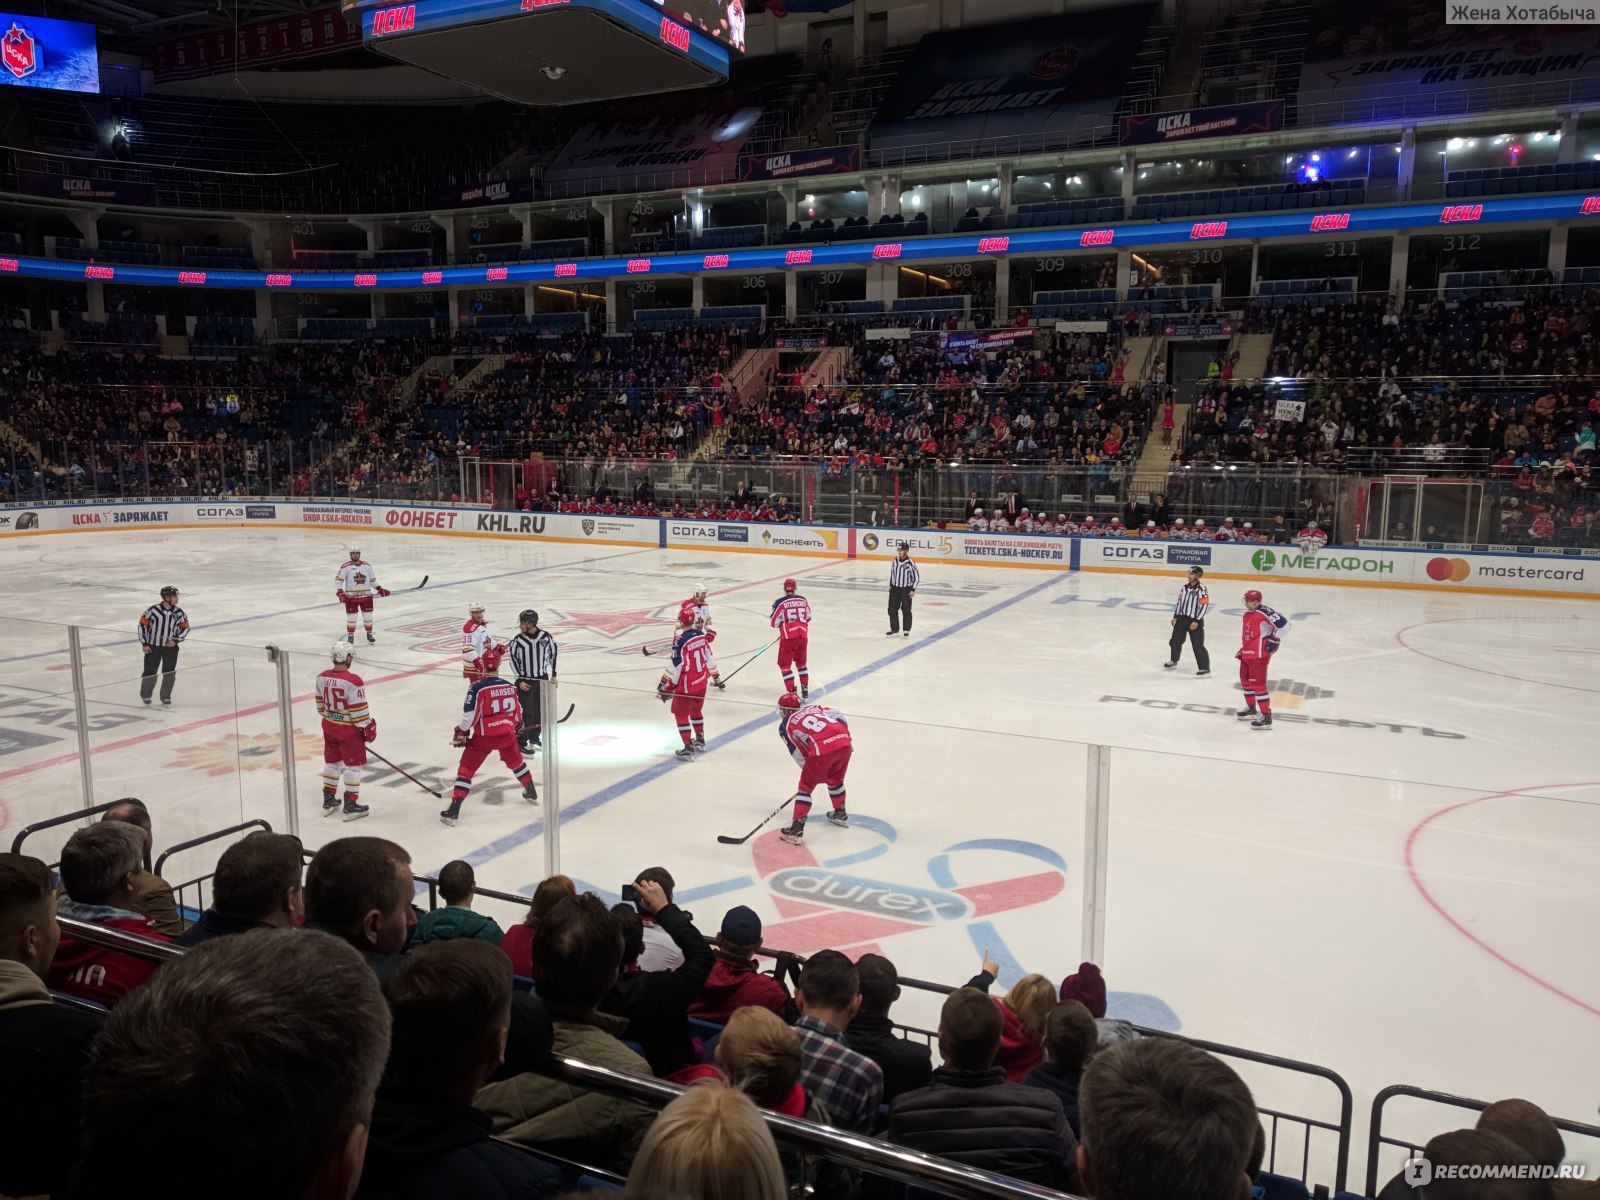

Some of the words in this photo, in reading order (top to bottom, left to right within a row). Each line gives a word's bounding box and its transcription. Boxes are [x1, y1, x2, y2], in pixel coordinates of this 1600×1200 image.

[373, 6, 415, 36] ЦСКА
[661, 18, 690, 52] ЦСКА
[6, 45, 28, 66] ЦСКА
[1352, 48, 1503, 76] ЗАРЯЖАЕТ
[1420, 66, 1460, 85] НА
[1463, 52, 1584, 80] ЭМОЦИИ
[904, 86, 1068, 120] ЗАРЯЖАЕТ
[1157, 113, 1190, 132] ЦСКА
[766, 154, 791, 170] ЦСКА
[63, 179, 91, 191] ЦСКА
[486, 182, 507, 198] ЦСКА
[567, 209, 587, 221] 404
[633, 204, 654, 216] 405
[1441, 204, 1483, 223] ЦСКА
[293, 224, 316, 235] 401
[411, 223, 431, 234] 402
[1311, 213, 1350, 232] ЦСКА
[1191, 221, 1227, 239] ЦСКА
[978, 237, 1009, 253] ЦСКА
[1080, 229, 1114, 247] ЦСКА
[1443, 235, 1480, 251] 312
[873, 243, 902, 259] ЦСКА
[1324, 241, 1359, 257] 311
[703, 255, 729, 269] ЦСКА
[785, 249, 813, 264] ЦСКА
[1190, 249, 1223, 264] 310
[555, 263, 577, 277] ЦСКА
[627, 259, 651, 273] ЦСКА
[945, 264, 972, 278] 308
[1035, 257, 1065, 272] 309
[85, 266, 114, 279] ЦСКА
[178, 271, 206, 284] ЦСКА
[422, 272, 442, 284] ЦСКА
[487, 268, 508, 281] ЦСКА
[819, 271, 843, 285] 307
[266, 274, 292, 286] ЦСКА
[354, 275, 377, 286] ЦСКА
[635, 281, 656, 293] 305
[742, 276, 766, 289] 306
[73, 513, 101, 525] ЦСКА
[113, 511, 169, 523] ЗАРЯЖАЕТ
[197, 508, 244, 517] СОГАЗ
[303, 514, 372, 524] SHOP.CSKA-HOCKEY.RU
[385, 510, 457, 529] ФОНБЕТ
[477, 513, 546, 534] KHL.RU
[672, 526, 716, 537] СОГАЗ
[773, 538, 824, 547] РОСНЕФТЬ
[964, 546, 1063, 559] TICKETS.CSKA-HOCKEY.RU
[1103, 546, 1164, 559] СОГАЗ
[1479, 565, 1585, 581] mastercard
[323, 686, 350, 712] 46
[490, 688, 515, 698] HANSEN
[490, 697, 517, 717] 12
[784, 874, 953, 922] durex
